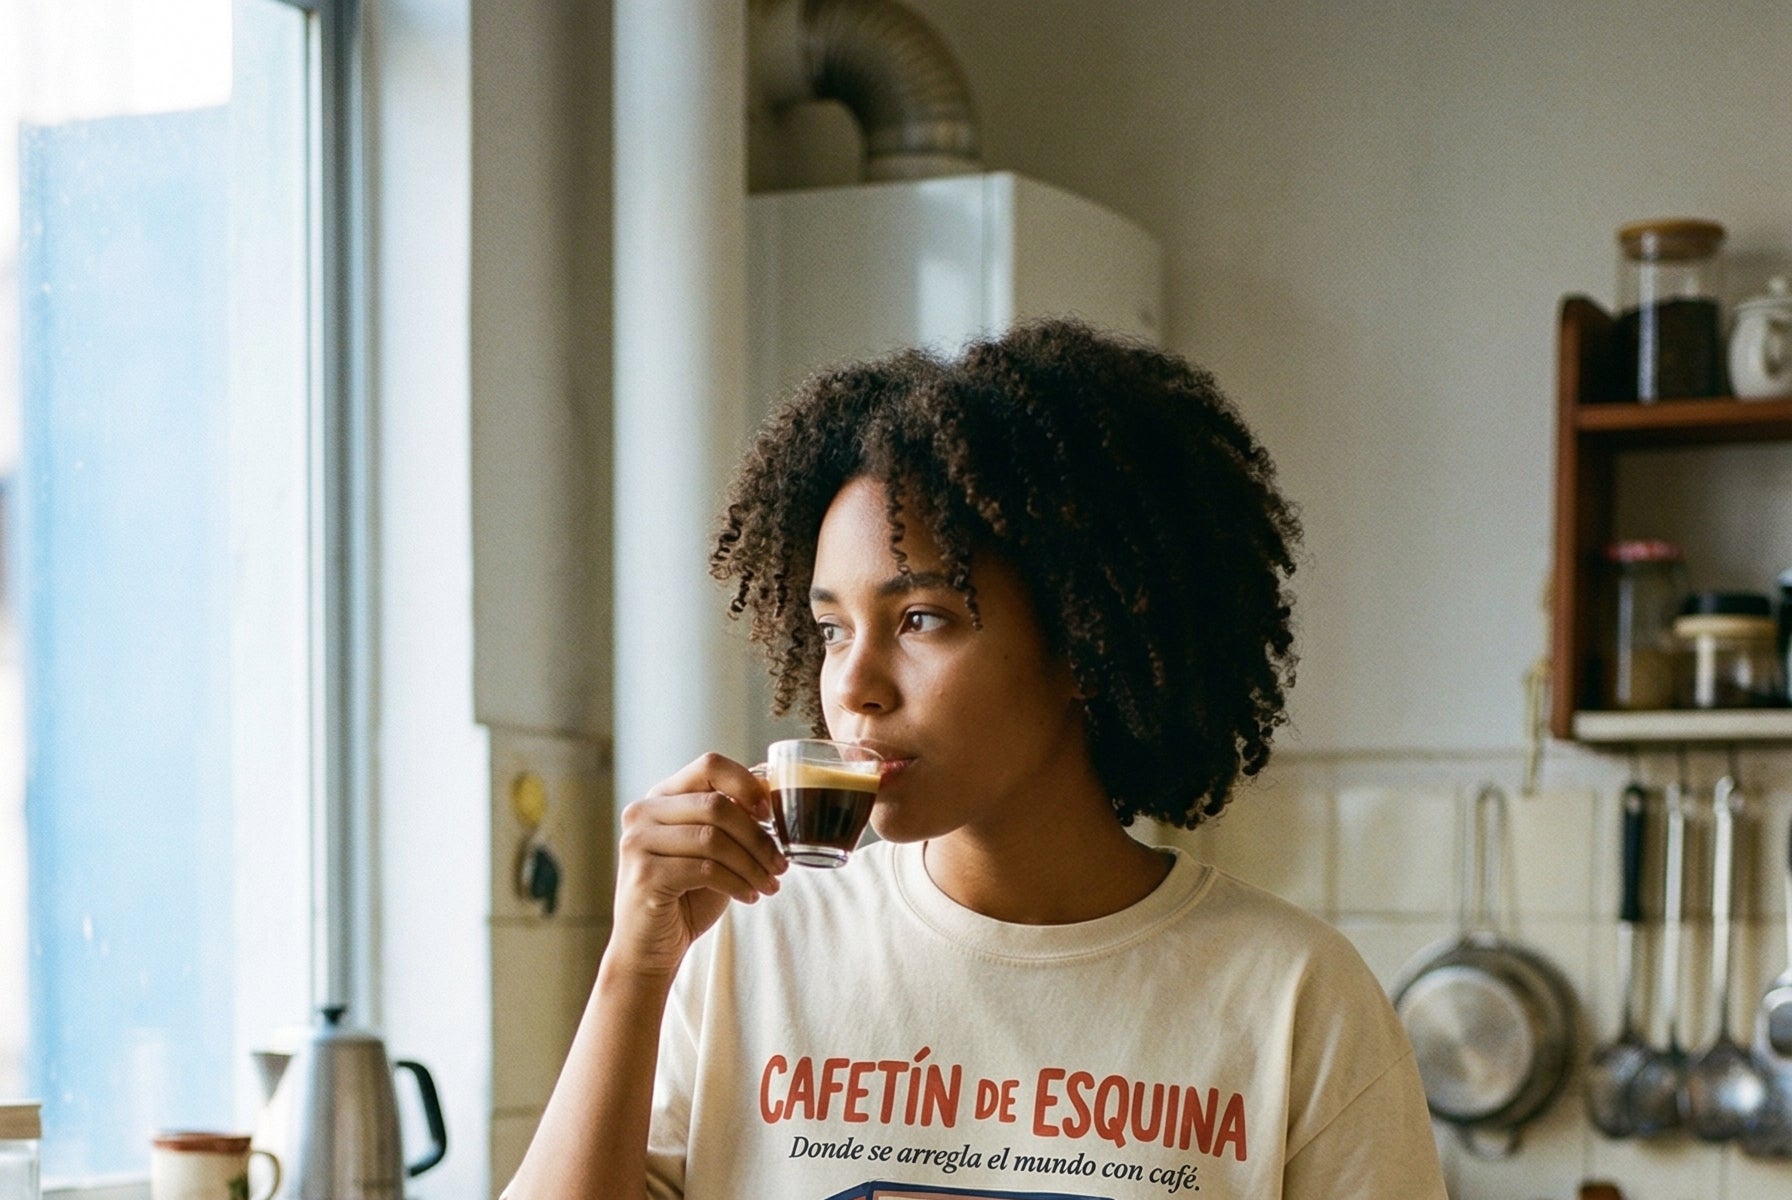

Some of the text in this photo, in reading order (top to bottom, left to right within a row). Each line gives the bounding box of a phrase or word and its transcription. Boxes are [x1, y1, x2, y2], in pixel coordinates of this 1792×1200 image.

[760, 1046, 1247, 1161] CAFETÍN DE ESQUINA
[789, 1136, 1201, 1194] Donde se arregla el mundo con café.
